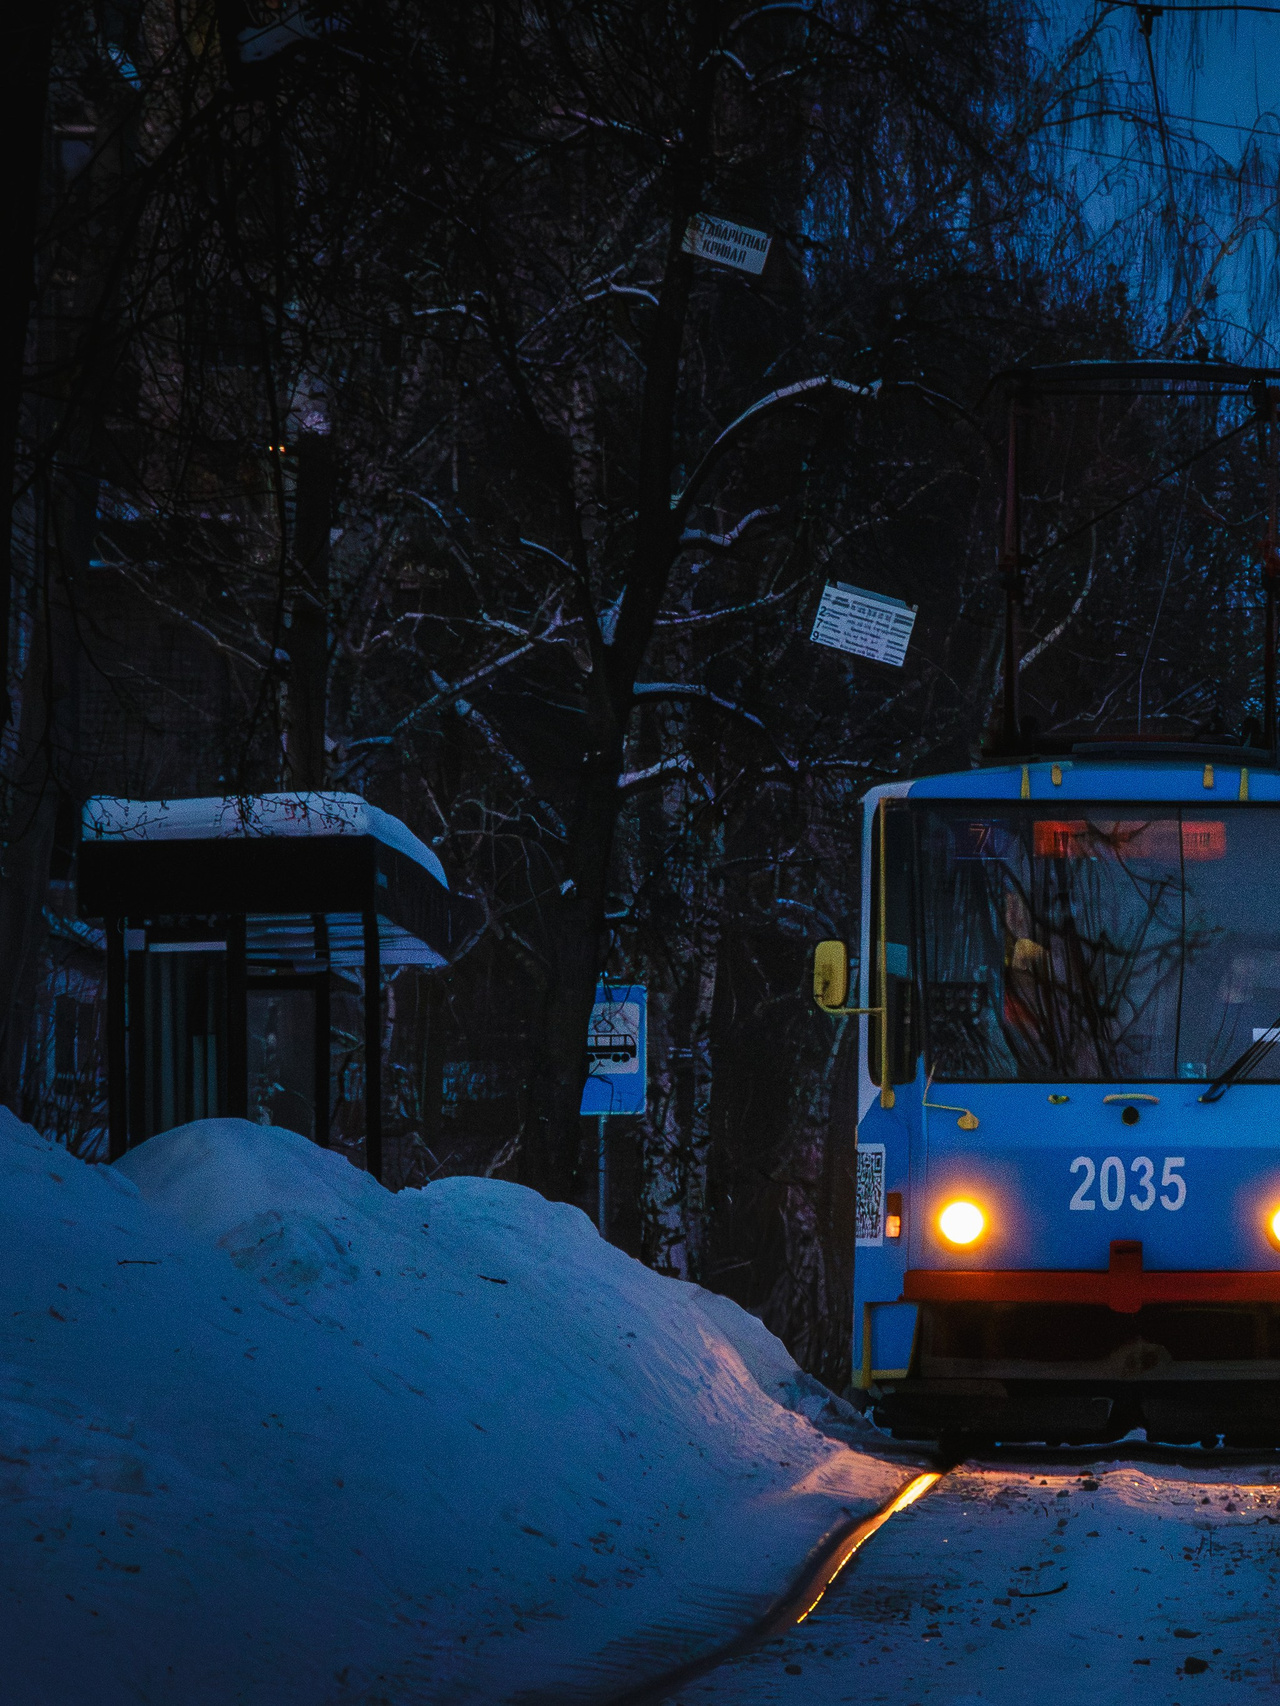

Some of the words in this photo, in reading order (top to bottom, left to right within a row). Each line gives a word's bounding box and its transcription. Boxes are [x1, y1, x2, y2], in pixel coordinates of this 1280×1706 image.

[702, 239, 747, 262] КРИВАЯ
[819, 606, 827, 616] 2
[817, 618, 823, 628] 7
[812, 631, 819, 640] 9
[1069, 1156, 1187, 1211] 2035
